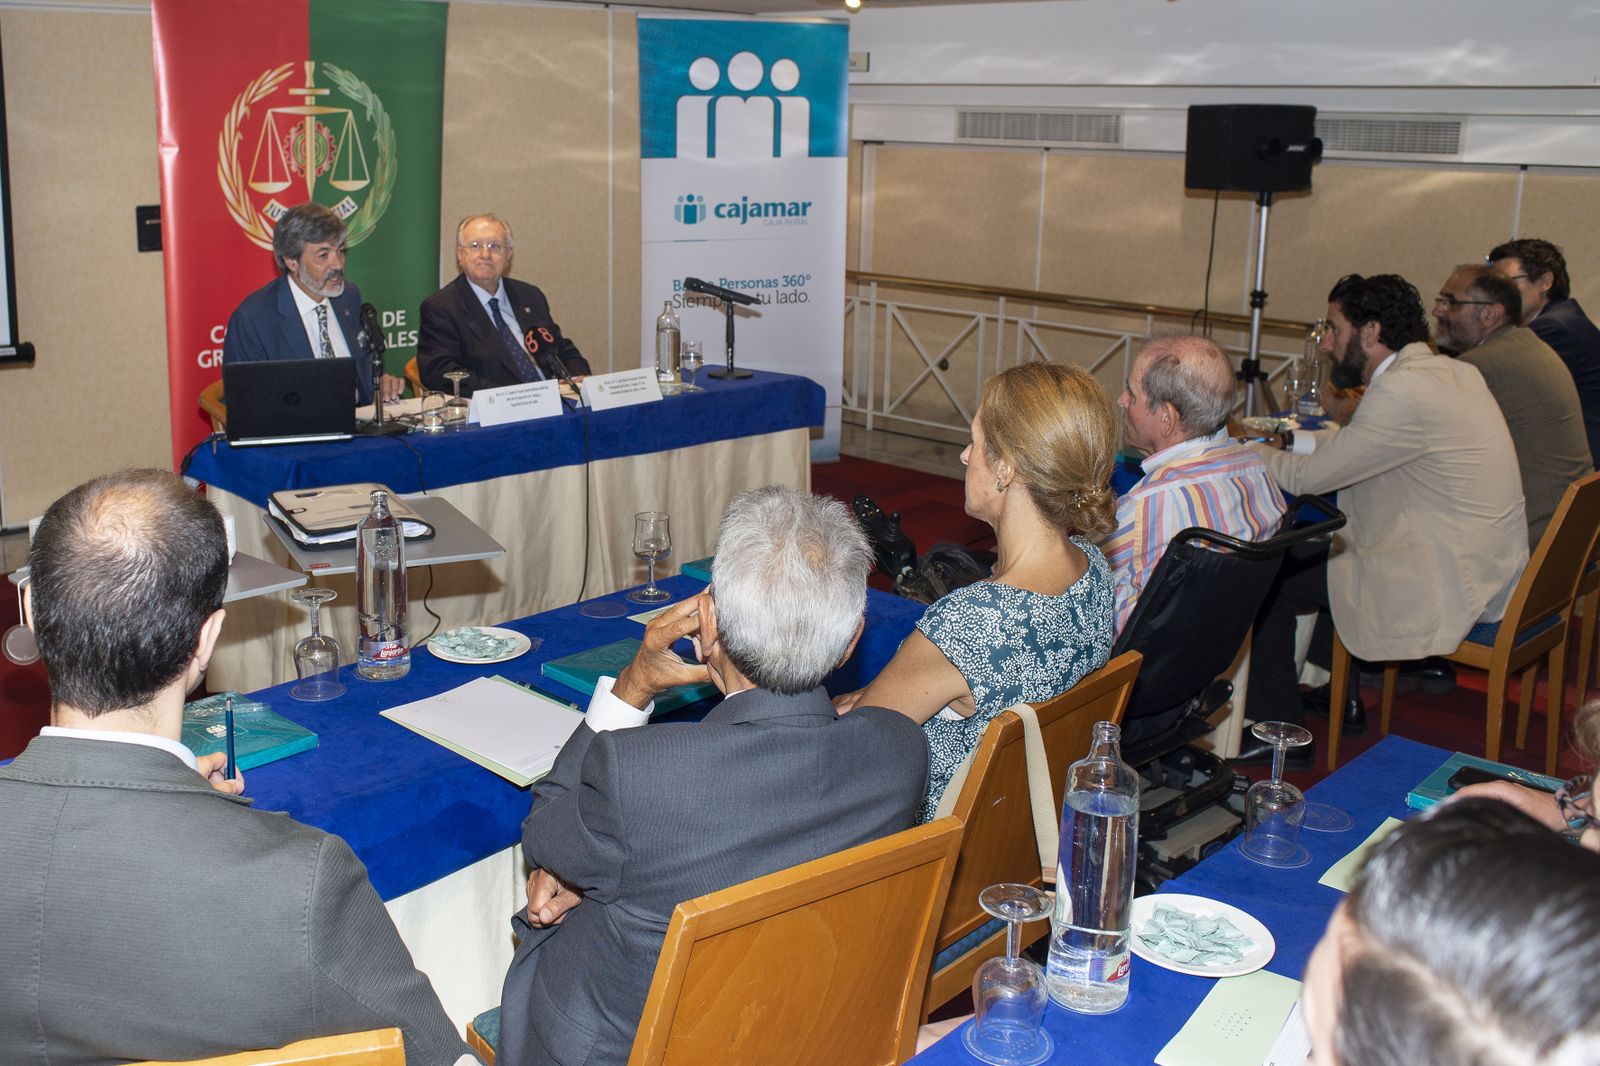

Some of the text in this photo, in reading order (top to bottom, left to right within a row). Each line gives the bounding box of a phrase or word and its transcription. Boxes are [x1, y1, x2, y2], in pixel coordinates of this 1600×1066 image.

[714, 196, 812, 225] cajamar
[719, 277, 779, 290] Personas
[672, 293, 727, 310] Siemp
[776, 288, 811, 304] lado.
[382, 311, 406, 327] DE
